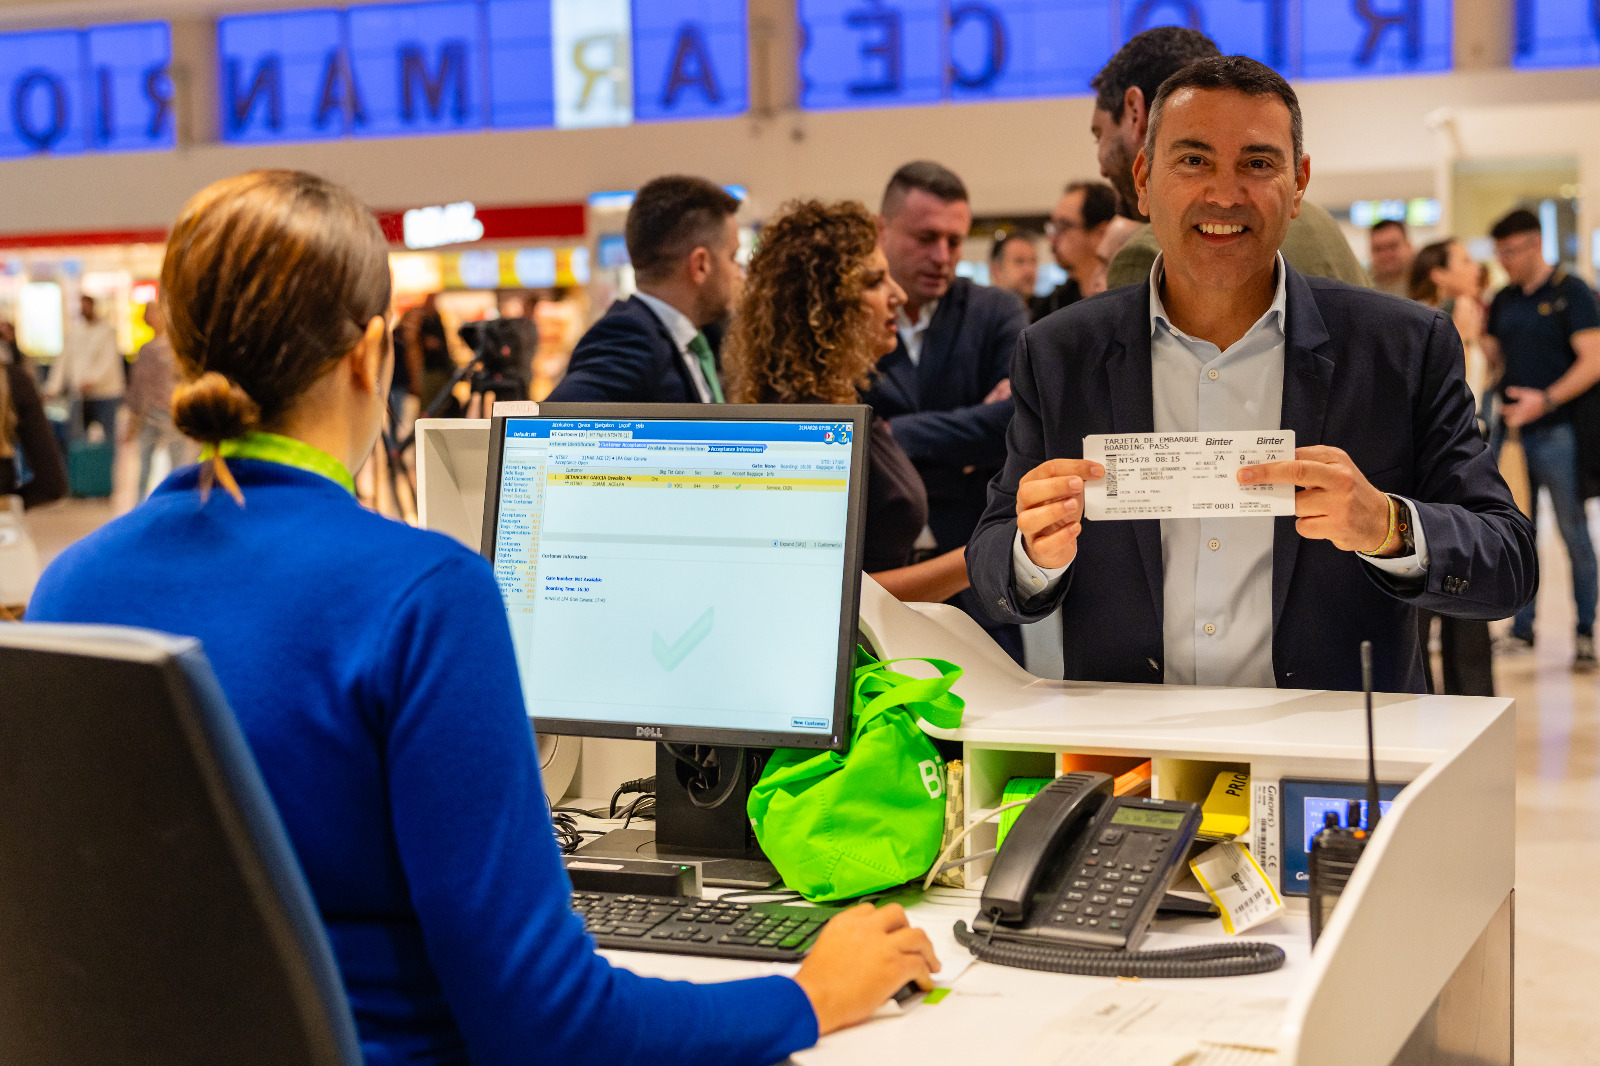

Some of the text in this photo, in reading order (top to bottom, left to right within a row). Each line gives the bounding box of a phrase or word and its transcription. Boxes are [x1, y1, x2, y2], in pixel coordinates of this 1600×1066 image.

[1104, 436, 1233, 446] TARJETA DE EMBARQUE Binter
[1256, 436, 1284, 446] Binter
[1104, 443, 1169, 452] BOARDING PASS
[1118, 456, 1150, 464] NT5478
[545, 585, 564, 593] Boarding
[793, 719, 826, 728] New Customer
[636, 726, 663, 738] DELL
[1267, 785, 1277, 823] GIROPES
[1231, 872, 1248, 893] Binter
